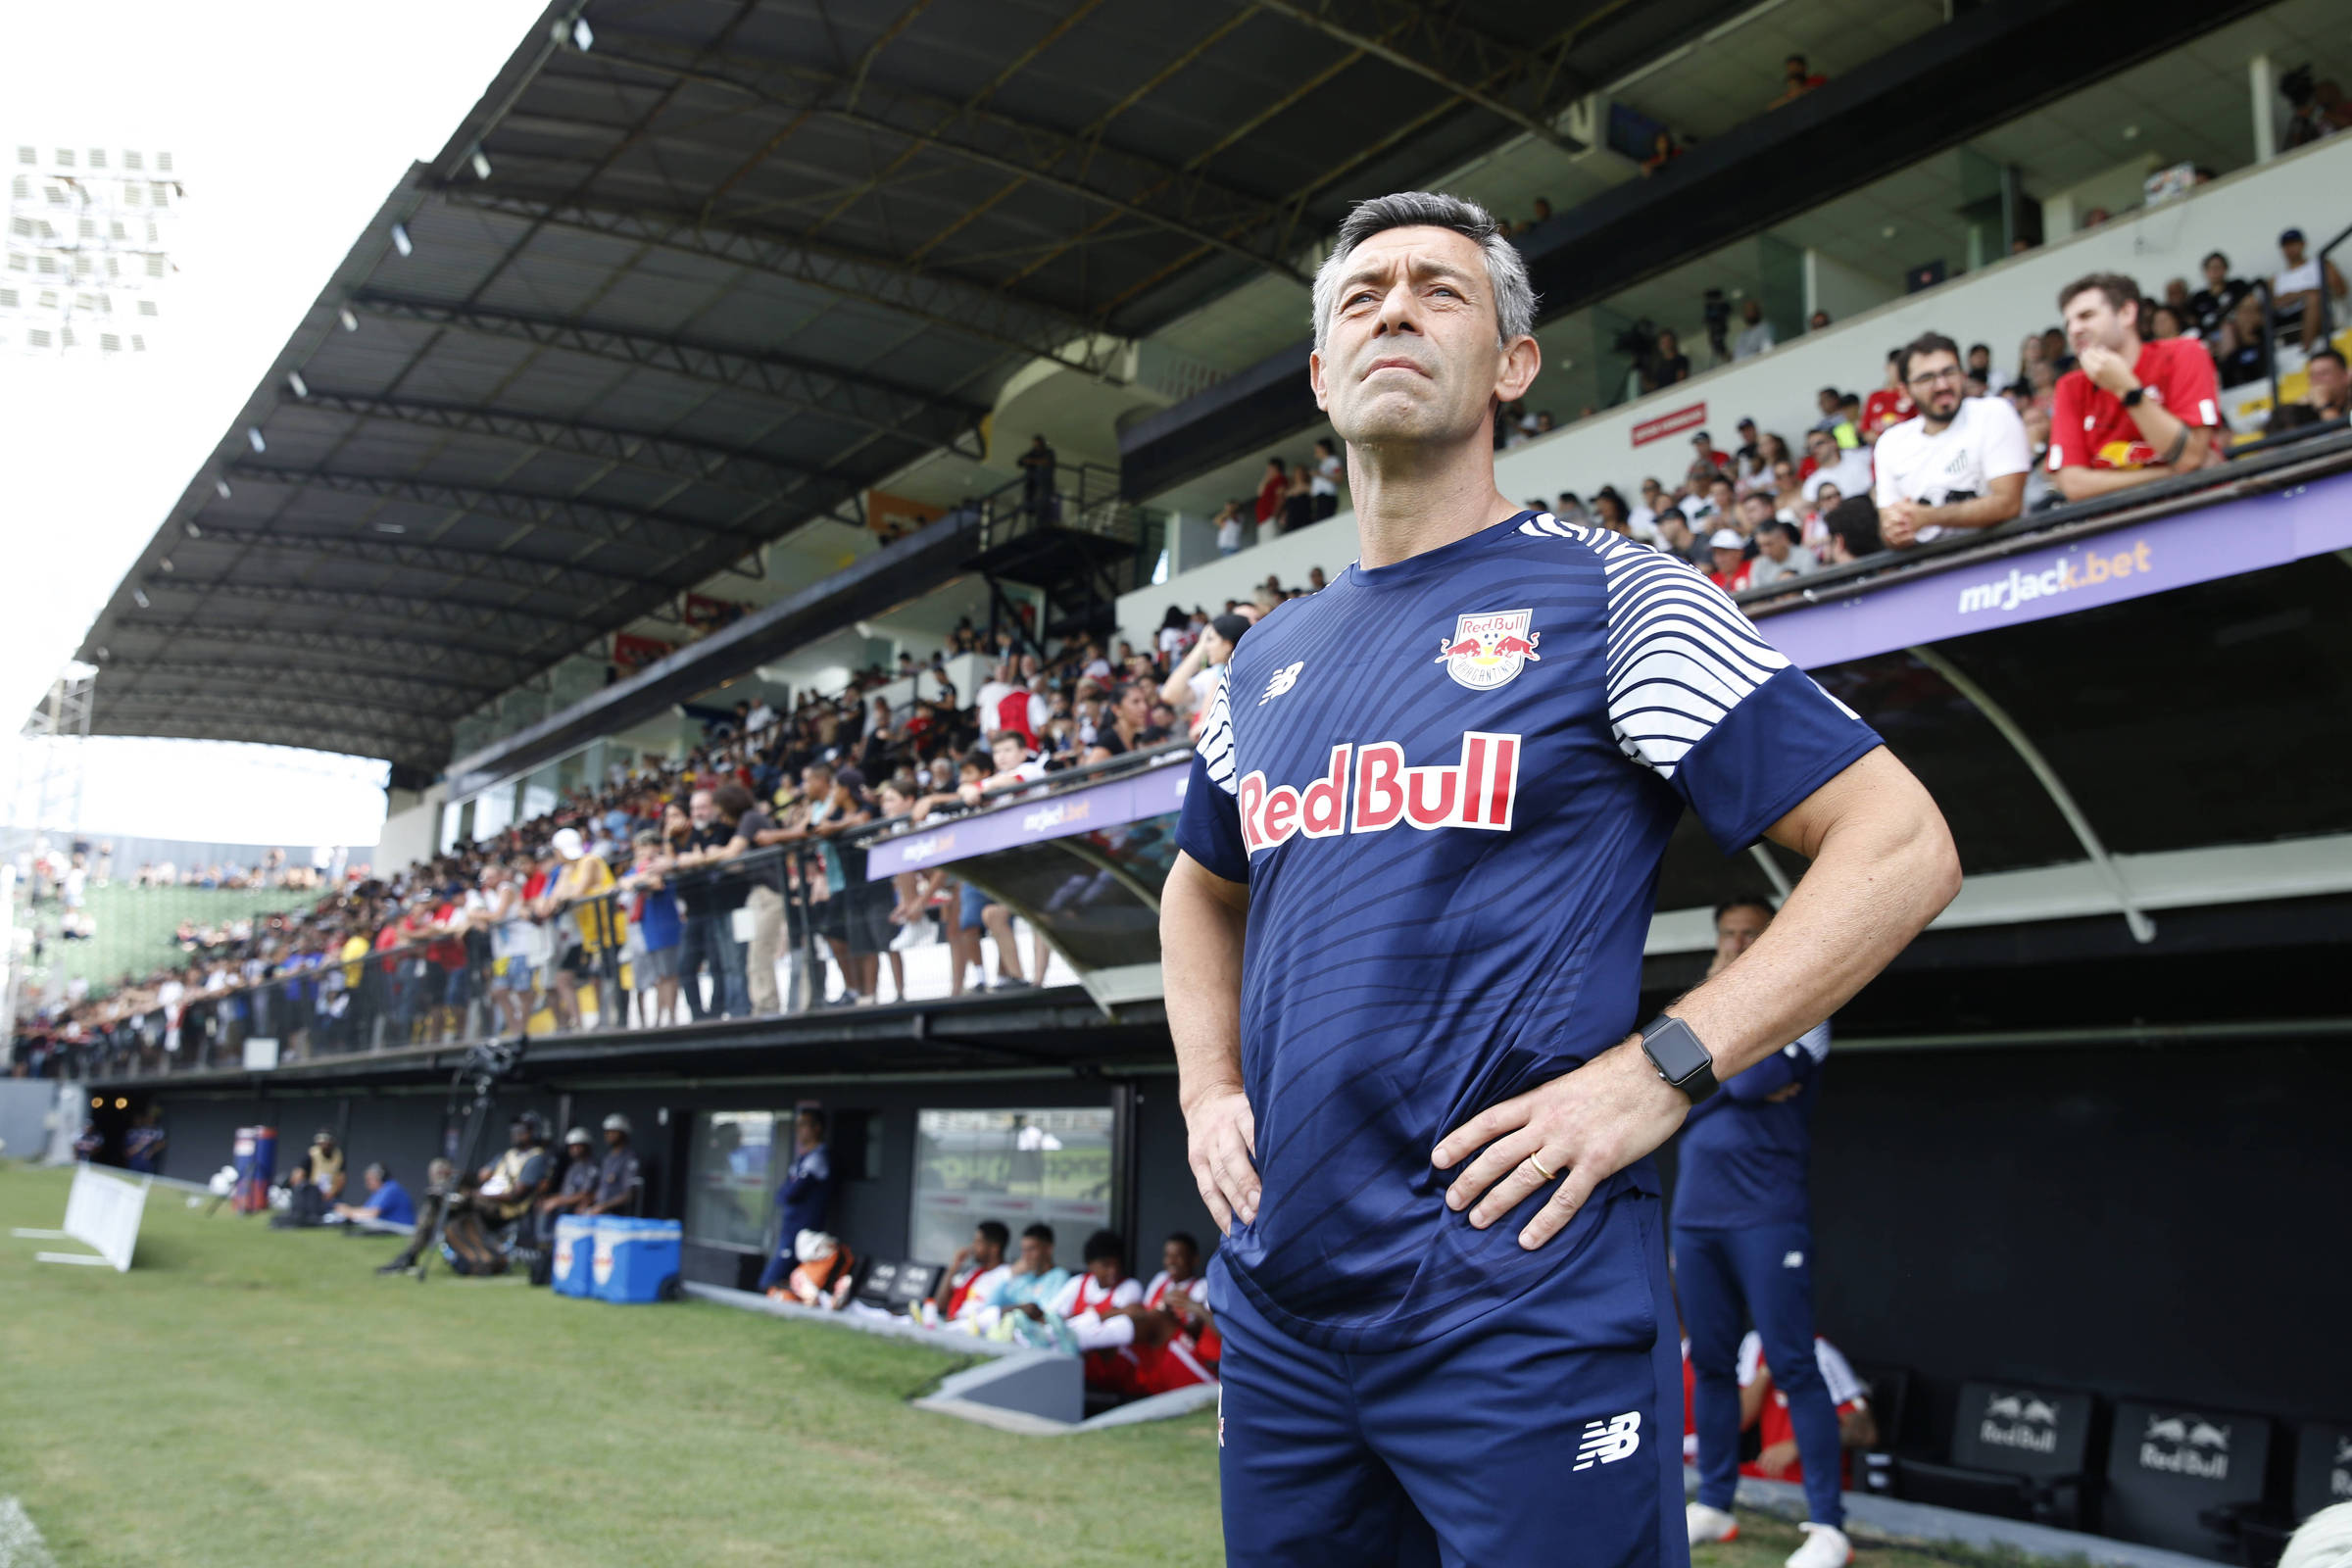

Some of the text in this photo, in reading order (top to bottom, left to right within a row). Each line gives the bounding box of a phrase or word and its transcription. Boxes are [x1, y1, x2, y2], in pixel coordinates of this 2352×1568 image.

[1462, 615, 1525, 634] Red Bull
[1240, 735, 1518, 851] Red Bull
